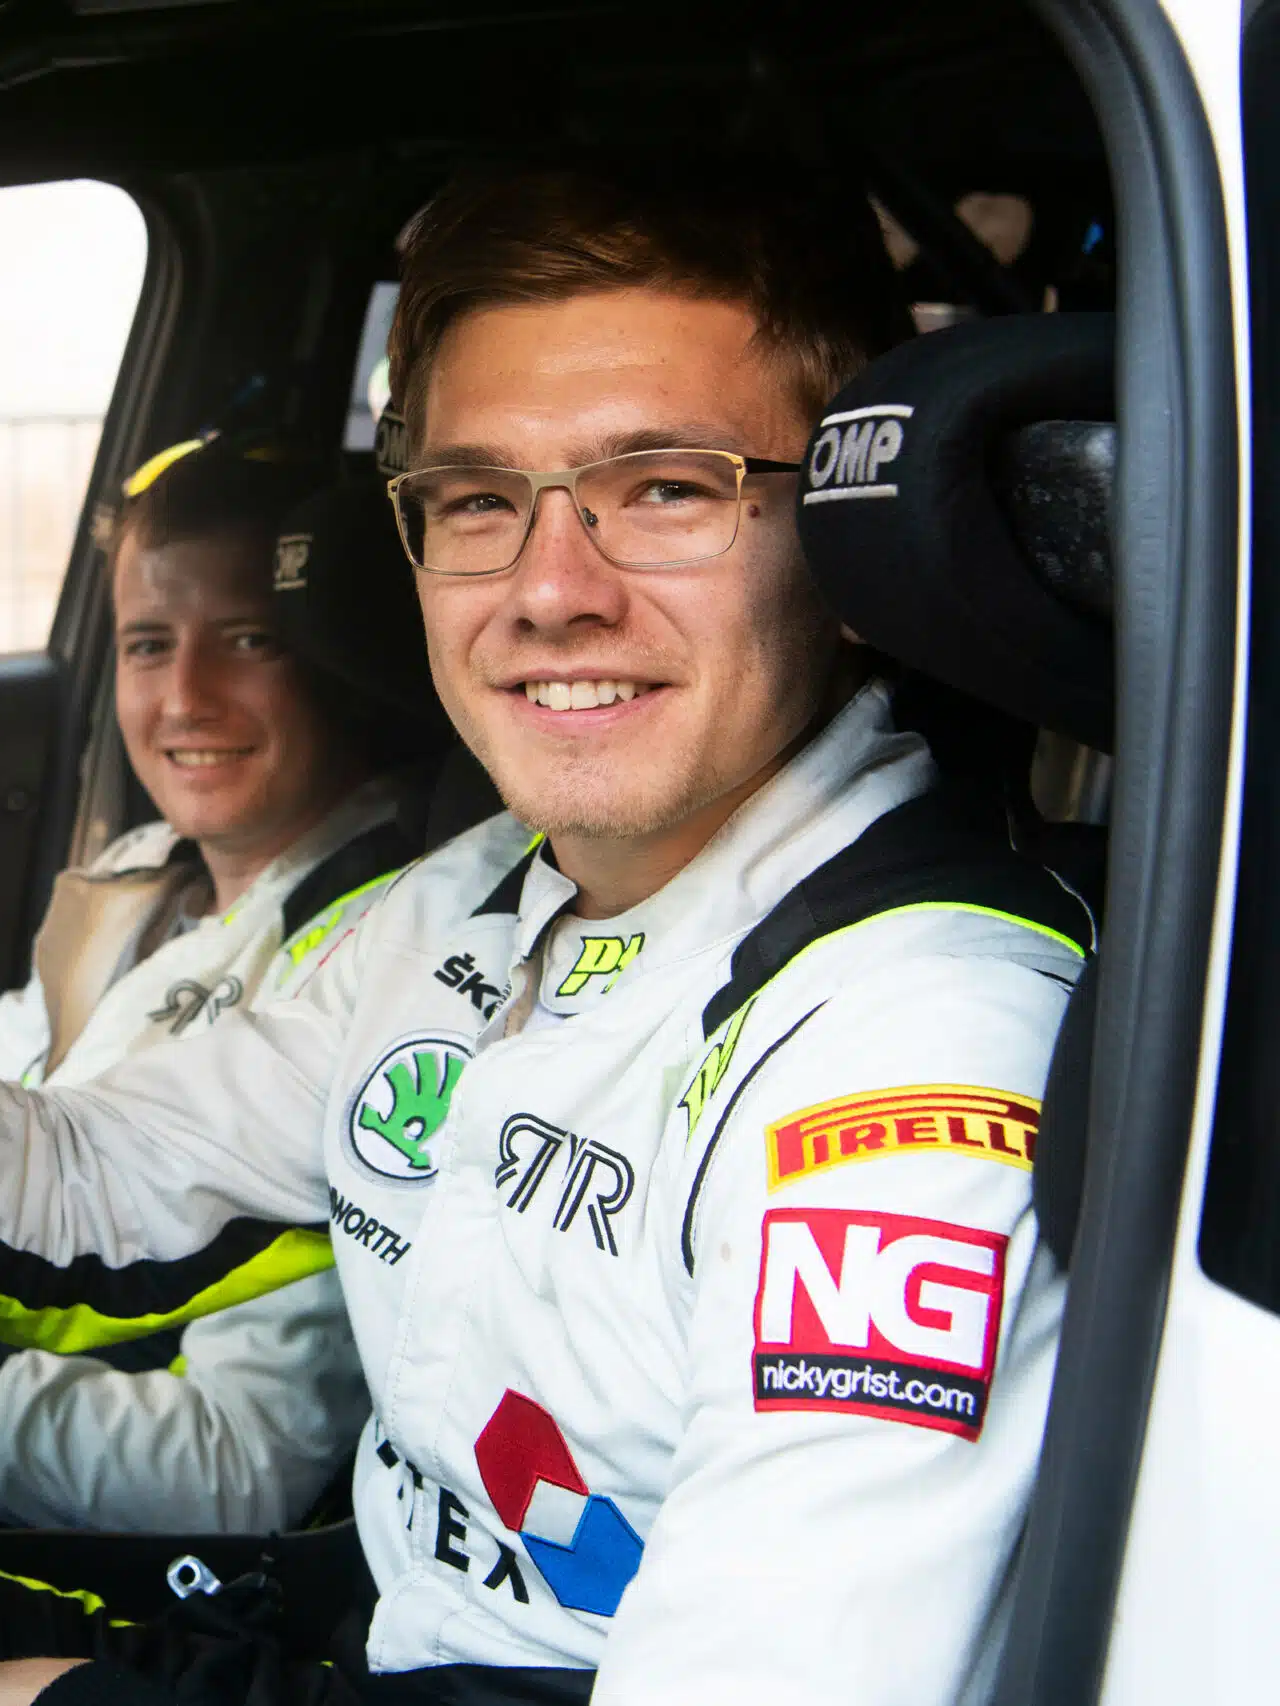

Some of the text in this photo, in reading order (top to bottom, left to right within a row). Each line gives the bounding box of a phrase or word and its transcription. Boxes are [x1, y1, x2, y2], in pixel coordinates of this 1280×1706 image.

[809, 419, 904, 488] OMP
[328, 1185, 412, 1267] WORTH
[760, 1221, 996, 1370] NG
[762, 1358, 975, 1416] nickygrist.com
